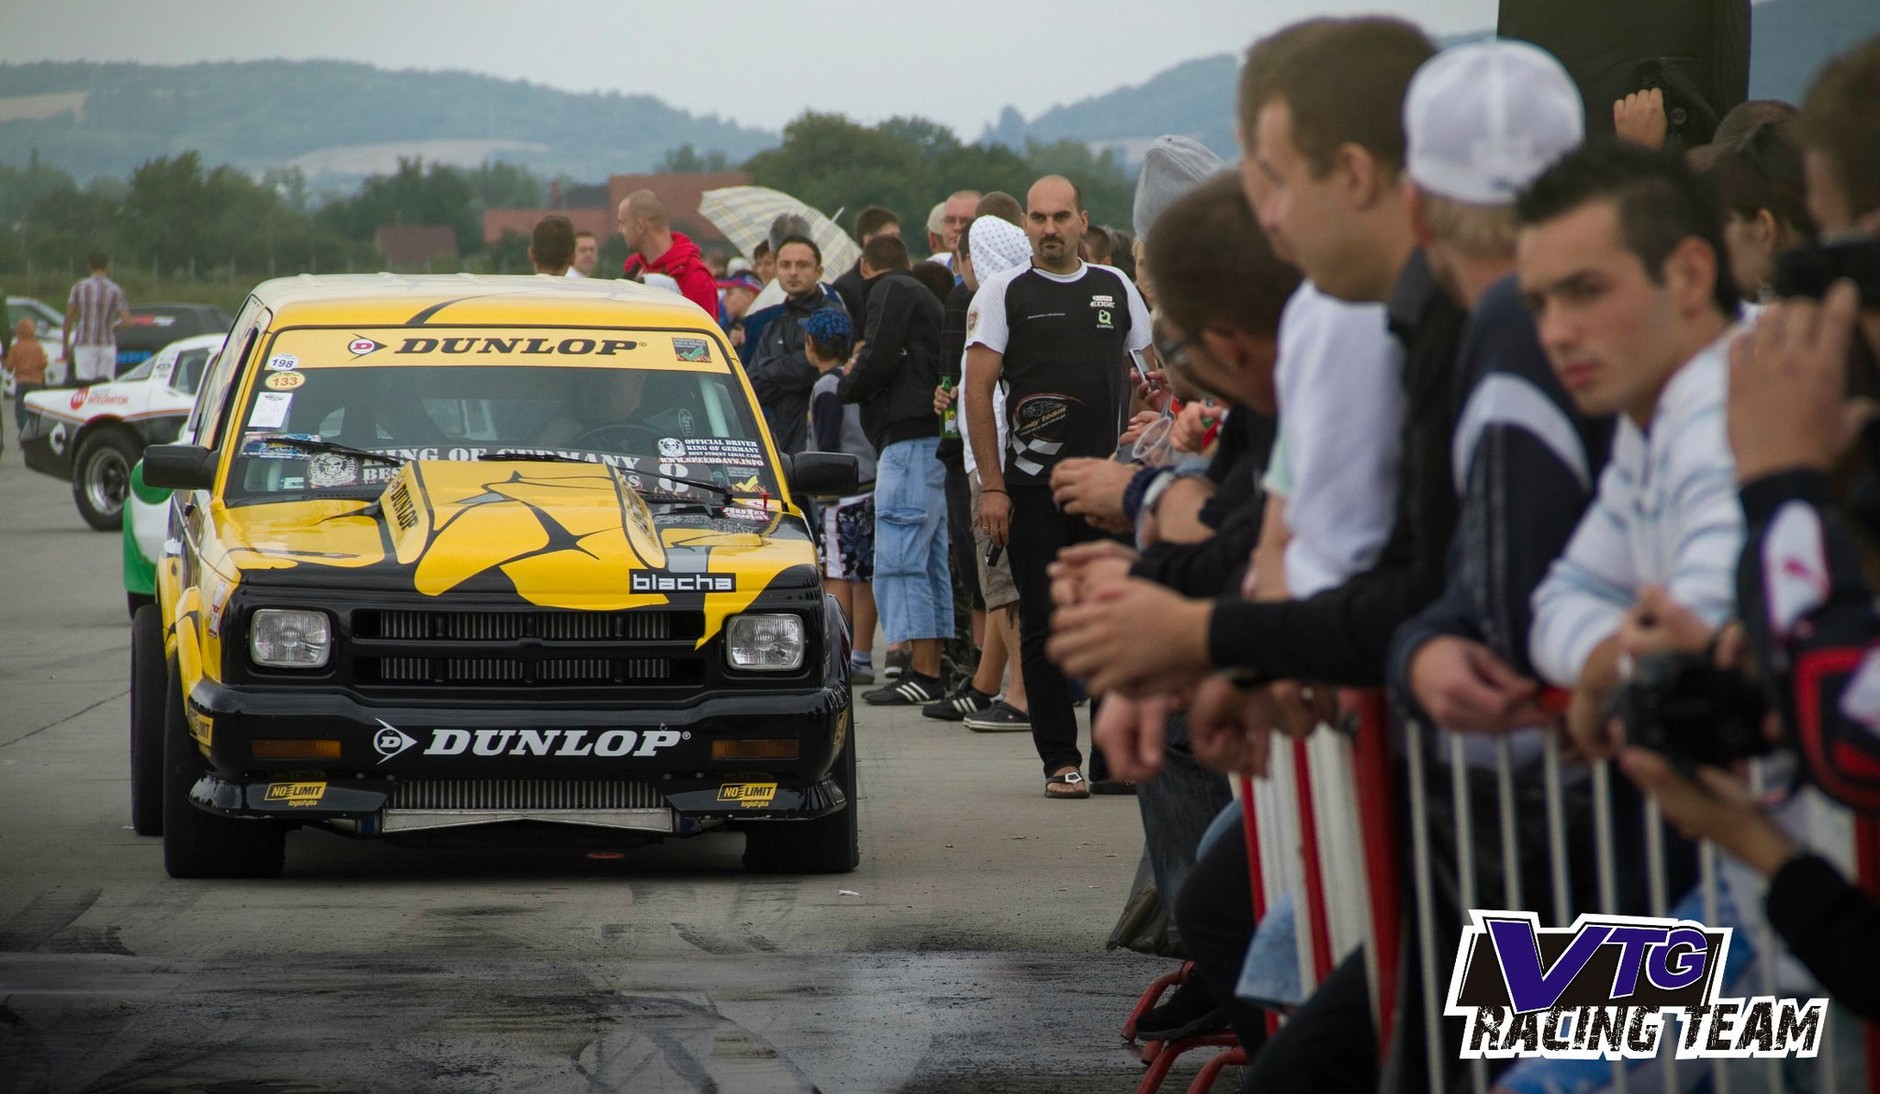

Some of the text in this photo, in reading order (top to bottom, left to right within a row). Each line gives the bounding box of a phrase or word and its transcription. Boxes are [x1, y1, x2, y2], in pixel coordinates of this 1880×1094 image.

[394, 337, 639, 356] DUNLOP
[272, 359, 294, 368] 198
[272, 377, 298, 387] 133
[362, 467, 400, 481] BES
[390, 483, 420, 531] DUNLOP
[633, 574, 732, 590] blacha
[422, 728, 682, 757] DUNLOP
[271, 785, 322, 798] NO LIMIT
[723, 786, 774, 798] NO LIMIT
